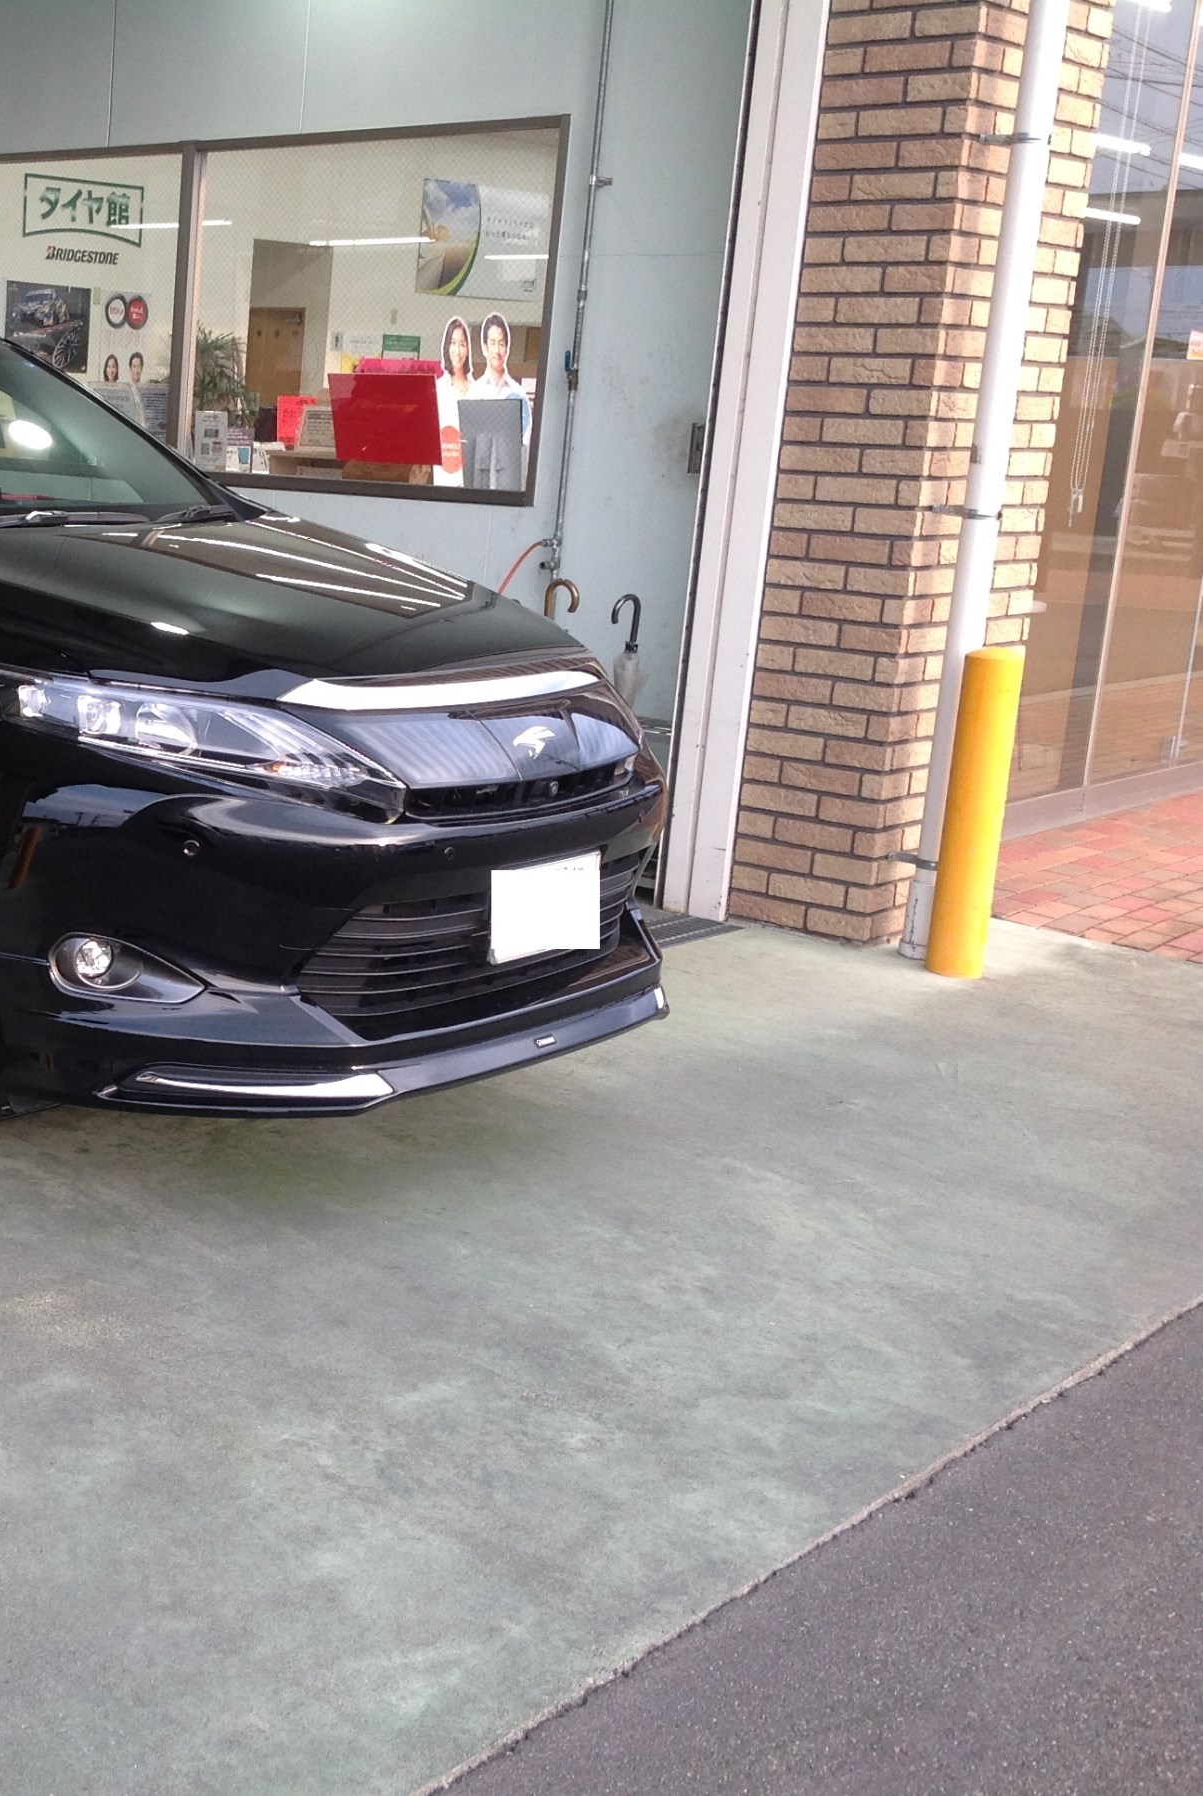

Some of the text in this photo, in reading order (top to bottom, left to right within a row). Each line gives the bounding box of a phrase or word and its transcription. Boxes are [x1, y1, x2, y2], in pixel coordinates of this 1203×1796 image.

[40, 186, 131, 226] タイヤ館
[45, 245, 120, 265] BRIDGESTONE
